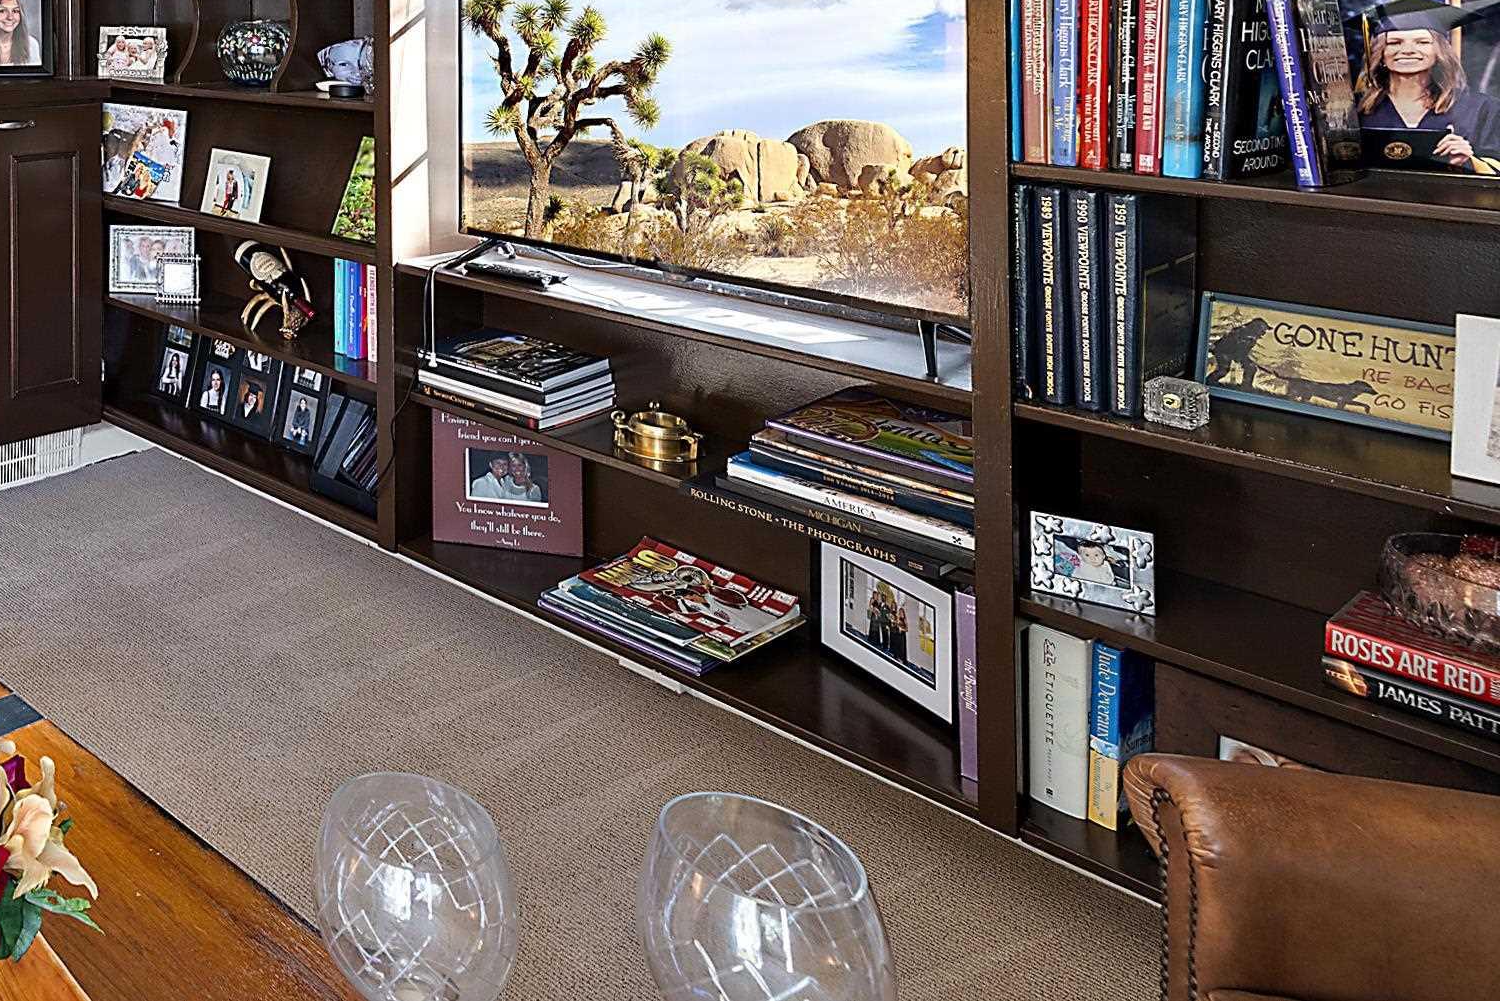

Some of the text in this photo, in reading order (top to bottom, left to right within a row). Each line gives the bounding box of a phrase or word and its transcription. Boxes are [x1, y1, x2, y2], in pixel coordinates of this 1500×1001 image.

[1055, 14, 1073, 57] Higgins
[1088, 13, 1098, 53] HIGGINS
[1119, 15, 1135, 55] Higgins
[1177, 17, 1188, 53] HIGGINS
[1211, 24, 1224, 68] HIGGINS
[1058, 58, 1072, 88] Clark
[1087, 54, 1097, 88] CLARK
[1122, 56, 1135, 83] Clark
[1176, 55, 1187, 84] CLARK
[1209, 70, 1221, 107] CLARK
[1204, 118, 1213, 162] TIME AROUND
[1212, 130, 1221, 158] SECOND
[1241, 154, 1278, 173] AROUND
[1041, 196, 1054, 284] 1989 VIEWPOINTE
[1077, 199, 1090, 290] 1990 VIEWPOINTE
[1114, 203, 1126, 295] 1991 VIEWPOINTE
[1081, 290, 1089, 314] GROSSE
[1116, 295, 1125, 321] GROSSE
[1274, 323, 1364, 358] GONE
[1046, 371, 1054, 396] SCHOOL
[1083, 377, 1091, 402] SCHOOL
[1117, 384, 1126, 410] SCHOOL
[1374, 394, 1406, 410] GO
[457, 428, 480, 440] friend
[481, 435, 497, 444] you
[498, 435, 517, 444] can't
[456, 501, 561, 524] You know whatever you do,
[806, 508, 864, 533] MICHIGAN
[822, 496, 878, 520] AMERICA
[470, 520, 546, 538] they'll still be there.
[690, 487, 898, 564] ROLLING STONE THE PHOTOGRAPHS
[1331, 628, 1486, 696] ROSES ARE RED
[1045, 671, 1056, 746] ETIQUETTE
[1095, 648, 1118, 743] Jude Deveraux
[1378, 681, 1444, 716] JAMES
